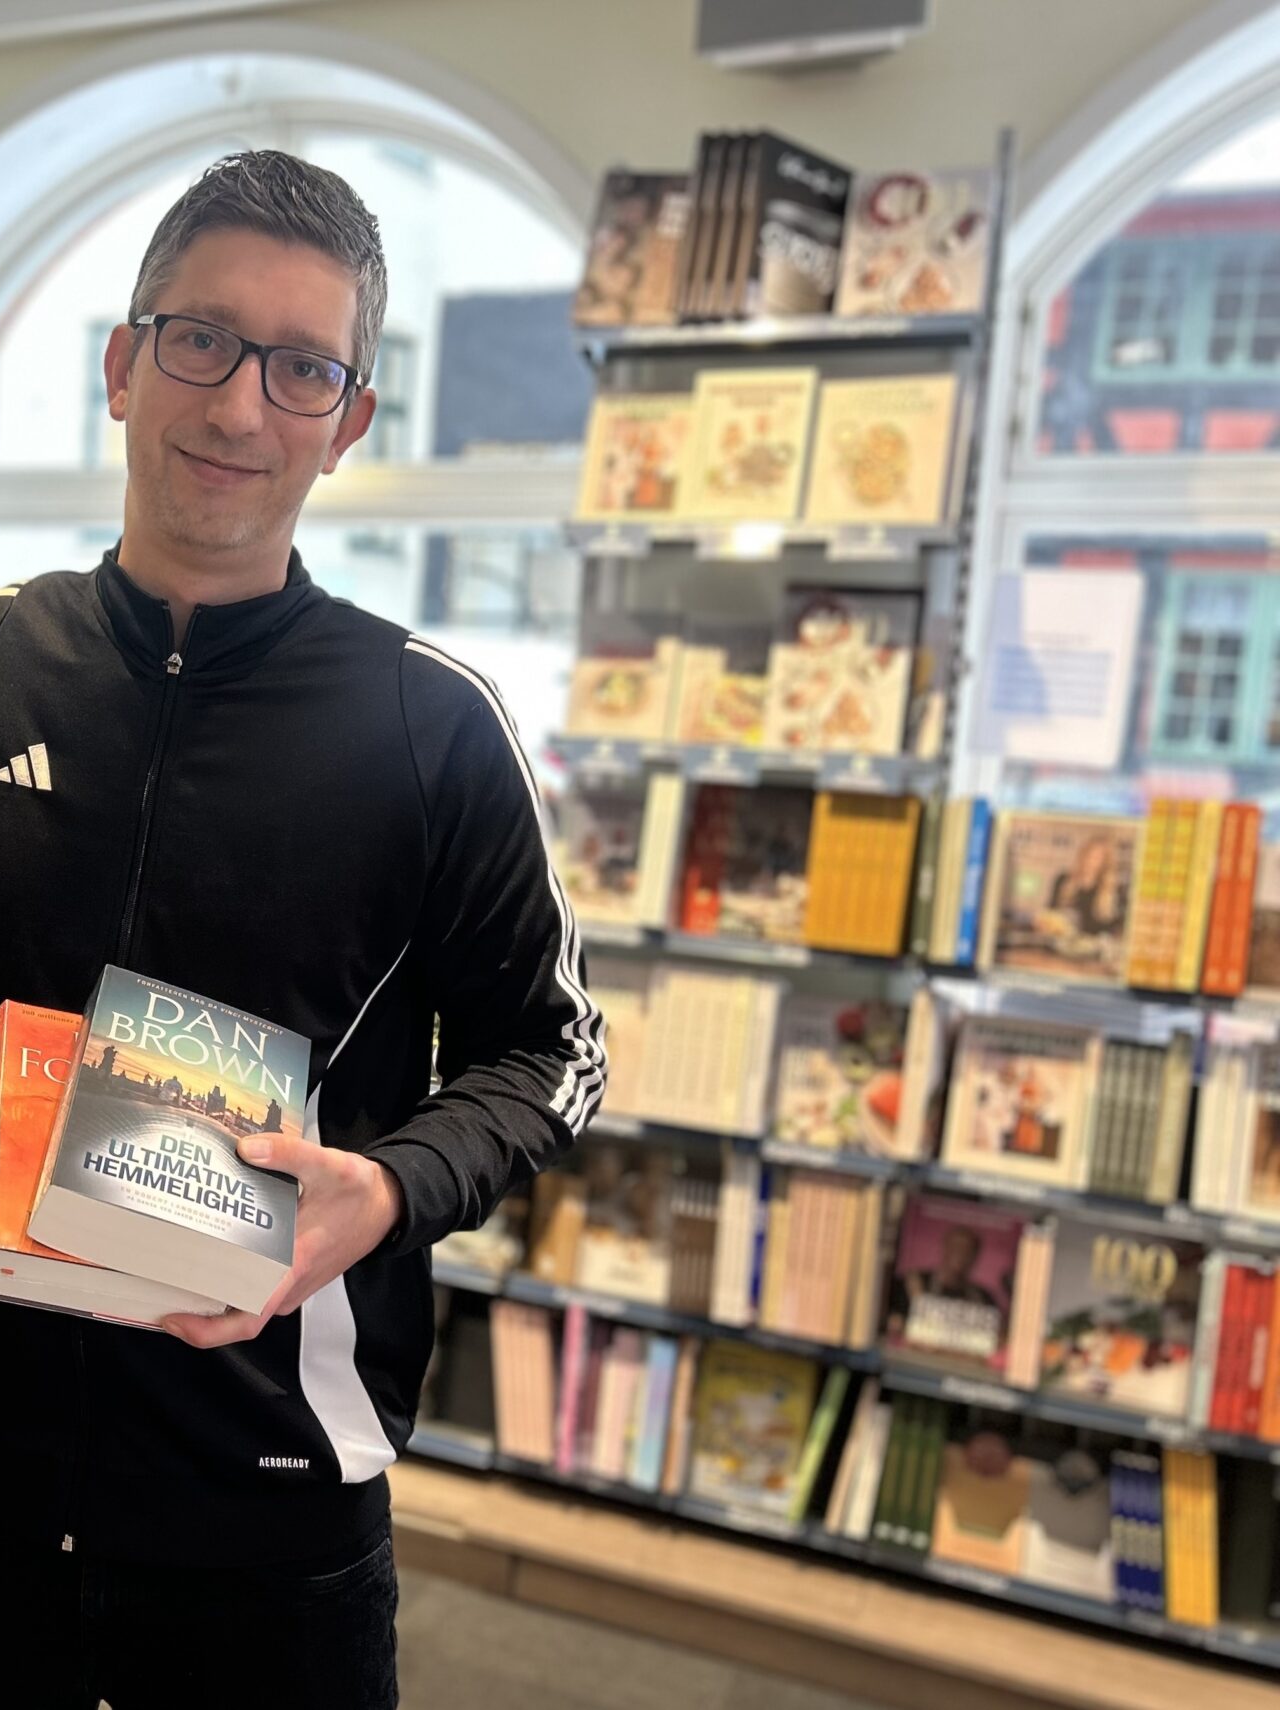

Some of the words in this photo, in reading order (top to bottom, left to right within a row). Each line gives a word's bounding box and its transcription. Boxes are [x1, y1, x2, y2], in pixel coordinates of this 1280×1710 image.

[143, 991, 269, 1061] DAN
[220, 1007, 241, 1019] VINCI
[106, 1011, 294, 1104] BROWN
[108, 1138, 256, 1204] ULTIMATIVE
[160, 1134, 212, 1166] DEN
[83, 1151, 273, 1230] HEMMELIGHED
[259, 1456, 310, 1469] AEROREADY
